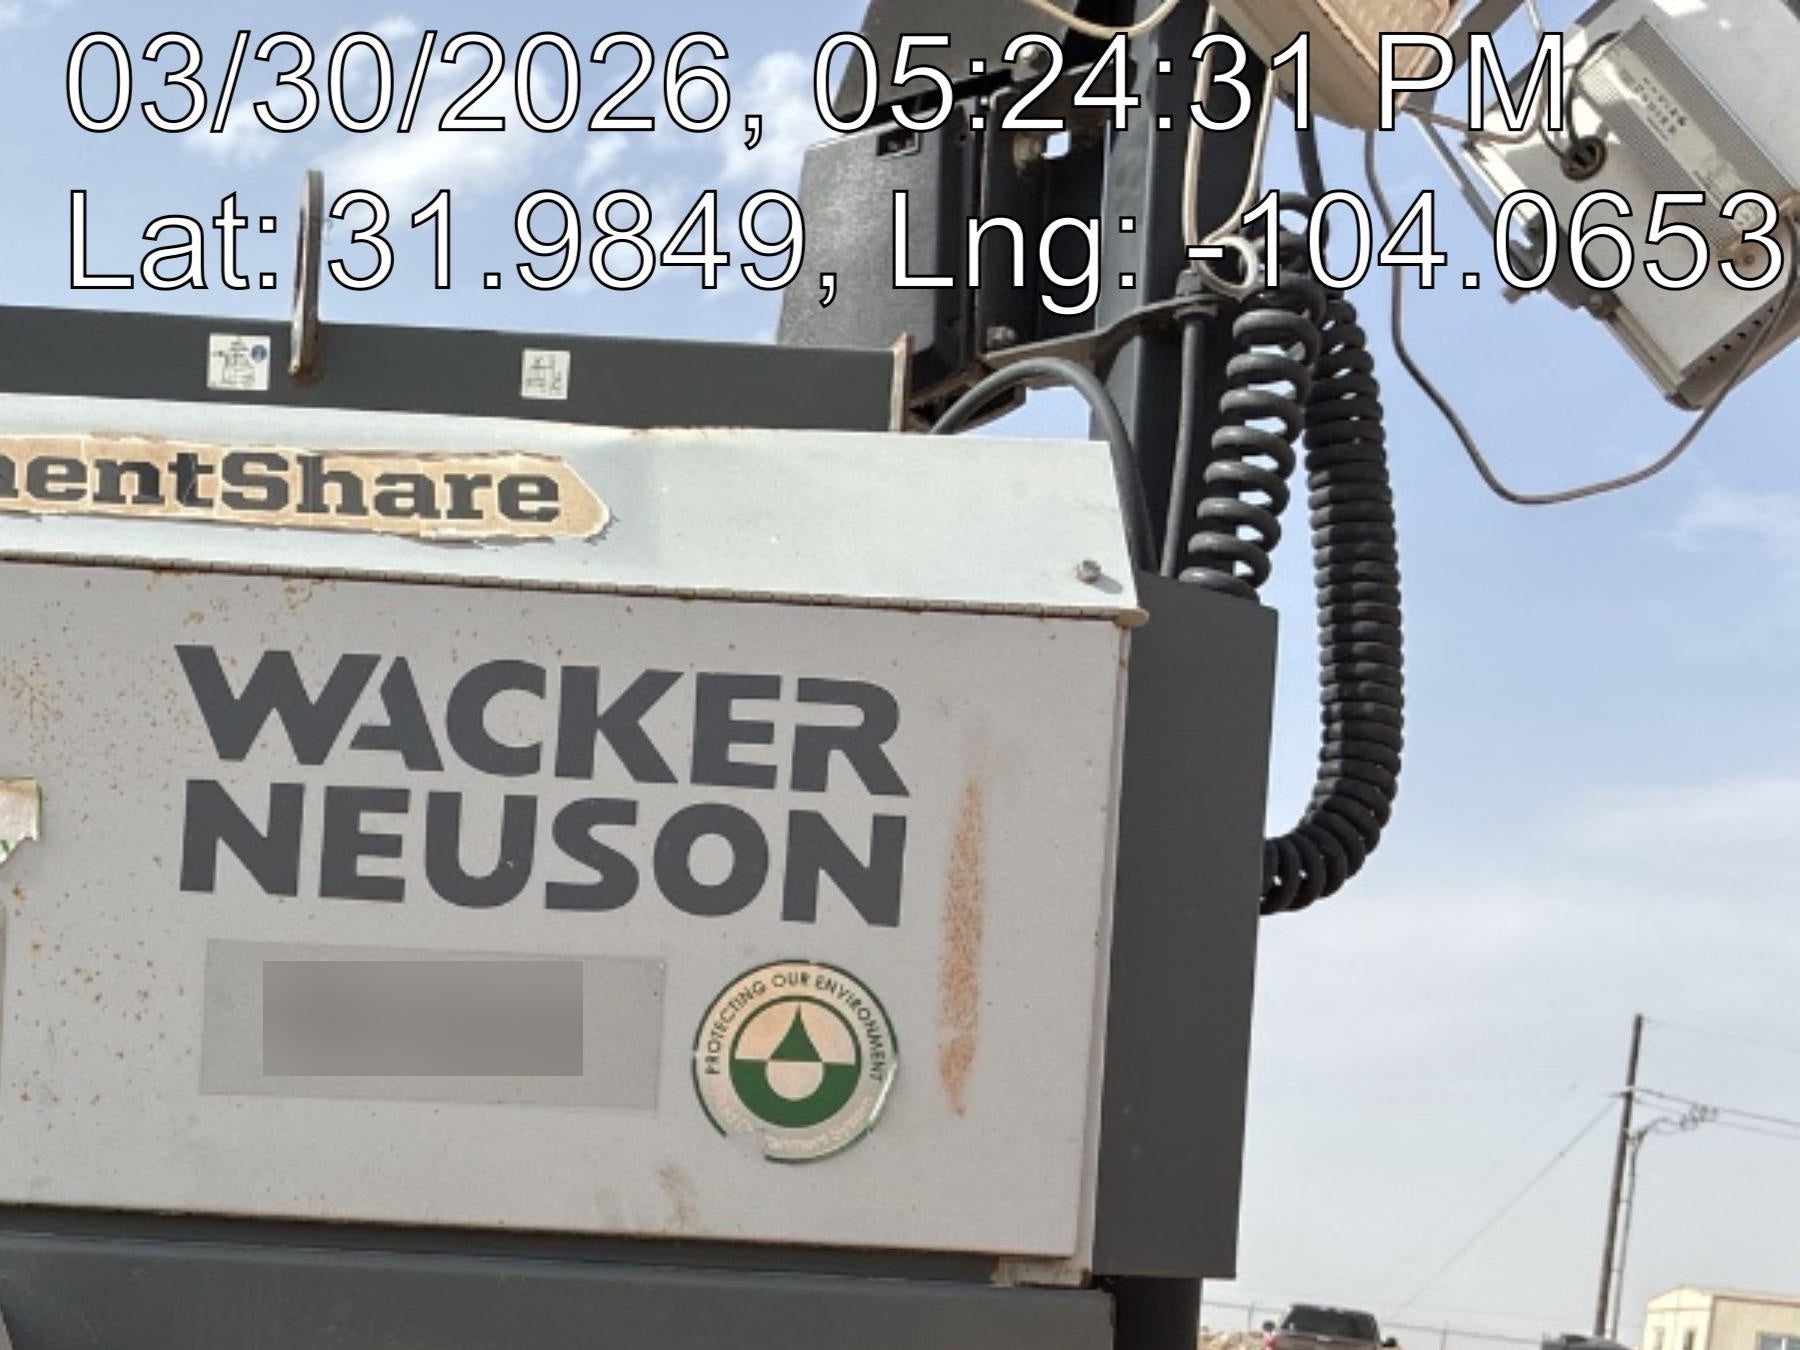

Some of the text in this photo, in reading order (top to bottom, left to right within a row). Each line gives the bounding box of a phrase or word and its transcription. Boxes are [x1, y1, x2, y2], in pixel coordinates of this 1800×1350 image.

[174, 645, 911, 797] WACKER
[179, 779, 908, 928] NEUSON
[704, 971, 887, 1083] PROTECTING OUR ENVIRONMENT
